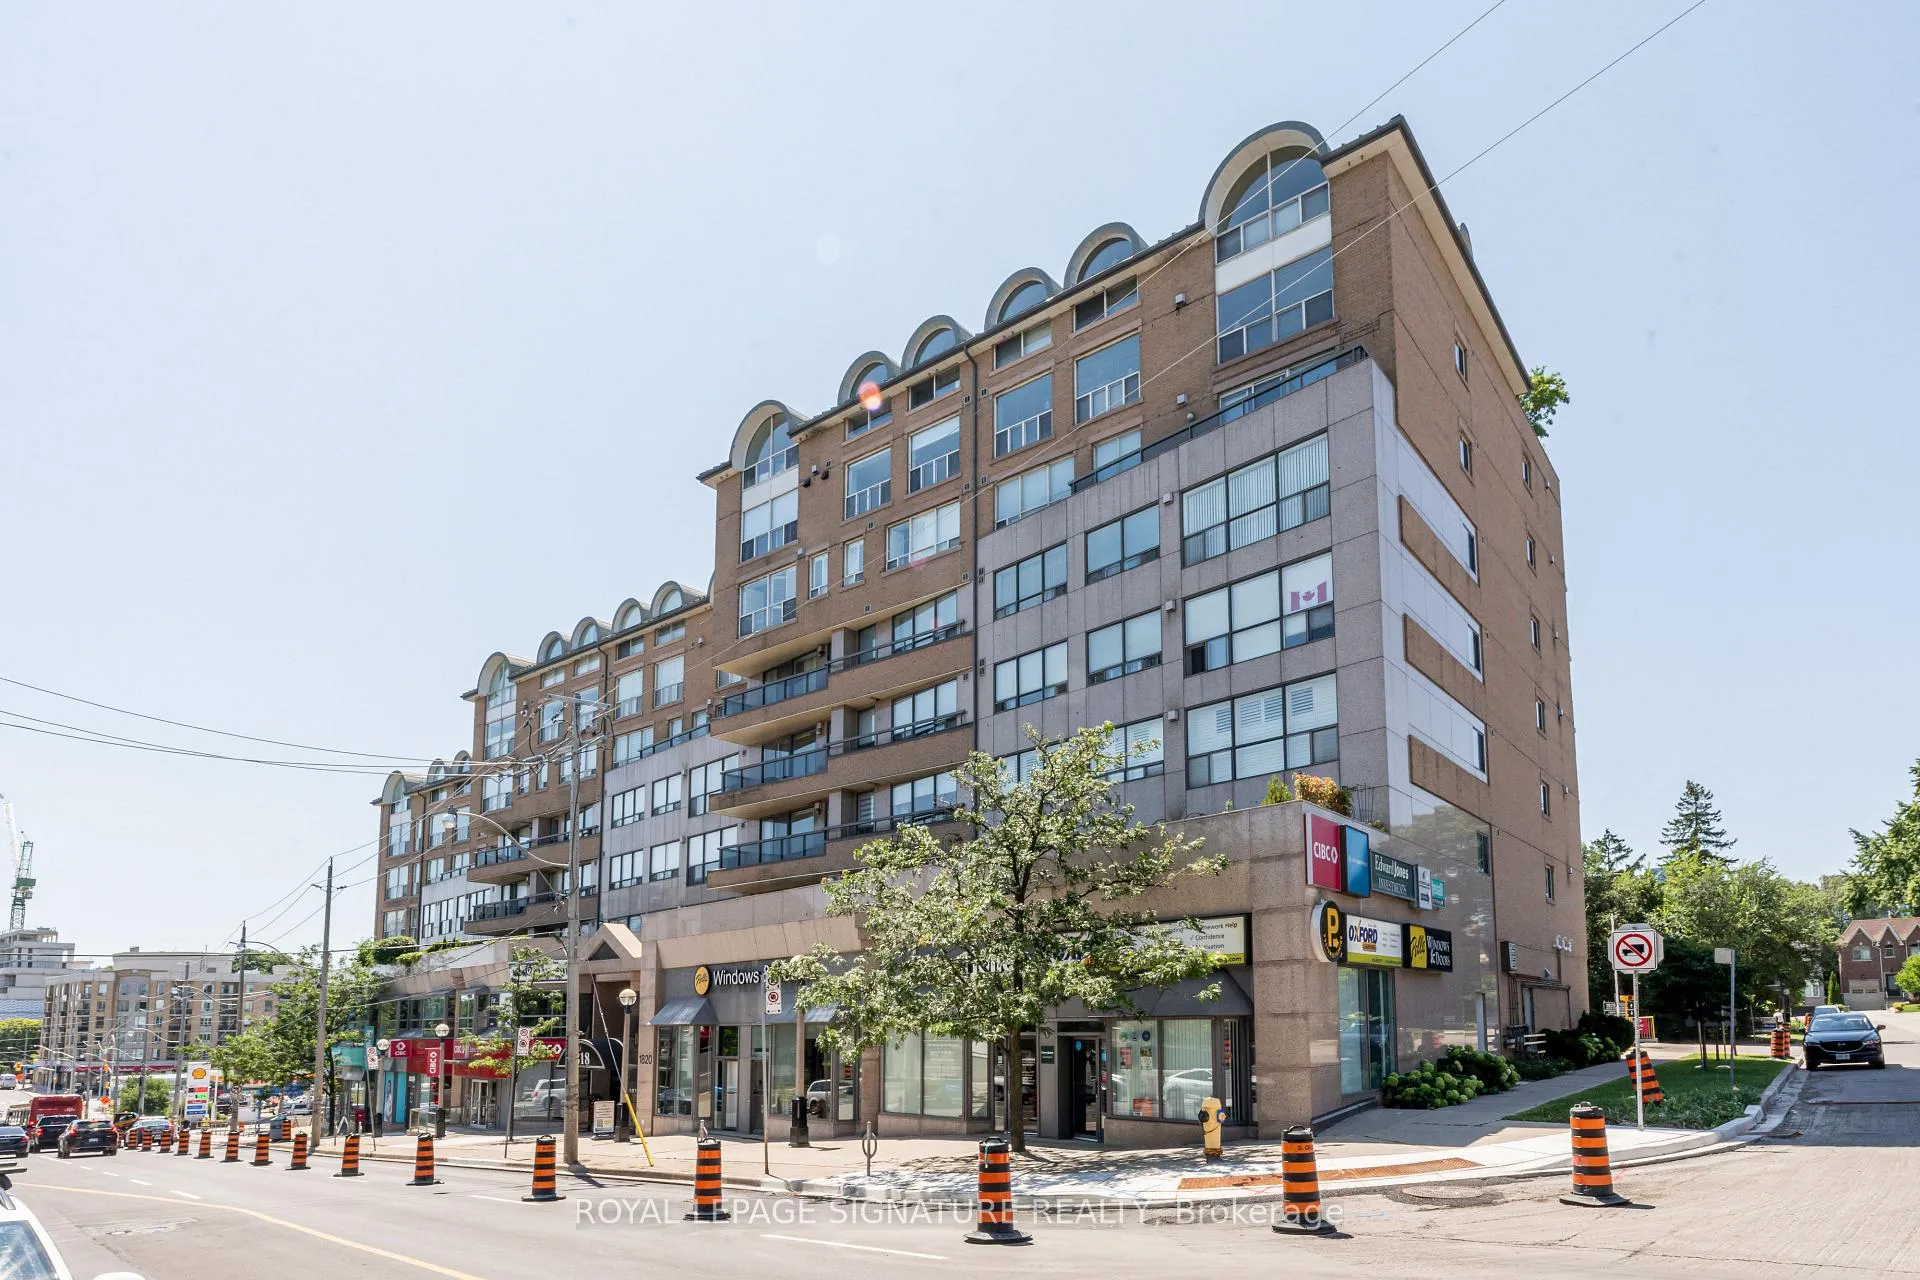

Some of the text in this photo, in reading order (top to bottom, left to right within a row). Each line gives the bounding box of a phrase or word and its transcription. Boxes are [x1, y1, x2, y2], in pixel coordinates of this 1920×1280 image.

[1313, 841, 1331, 861] CIBC
[1348, 921, 1378, 943] OXFORD
[1427, 935, 1450, 952] WINDOWS
[1431, 949, 1451, 967] & DOORS
[713, 969, 760, 985] Windows
[429, 1058, 437, 1074] CIBC
[639, 1054, 653, 1065] 1820
